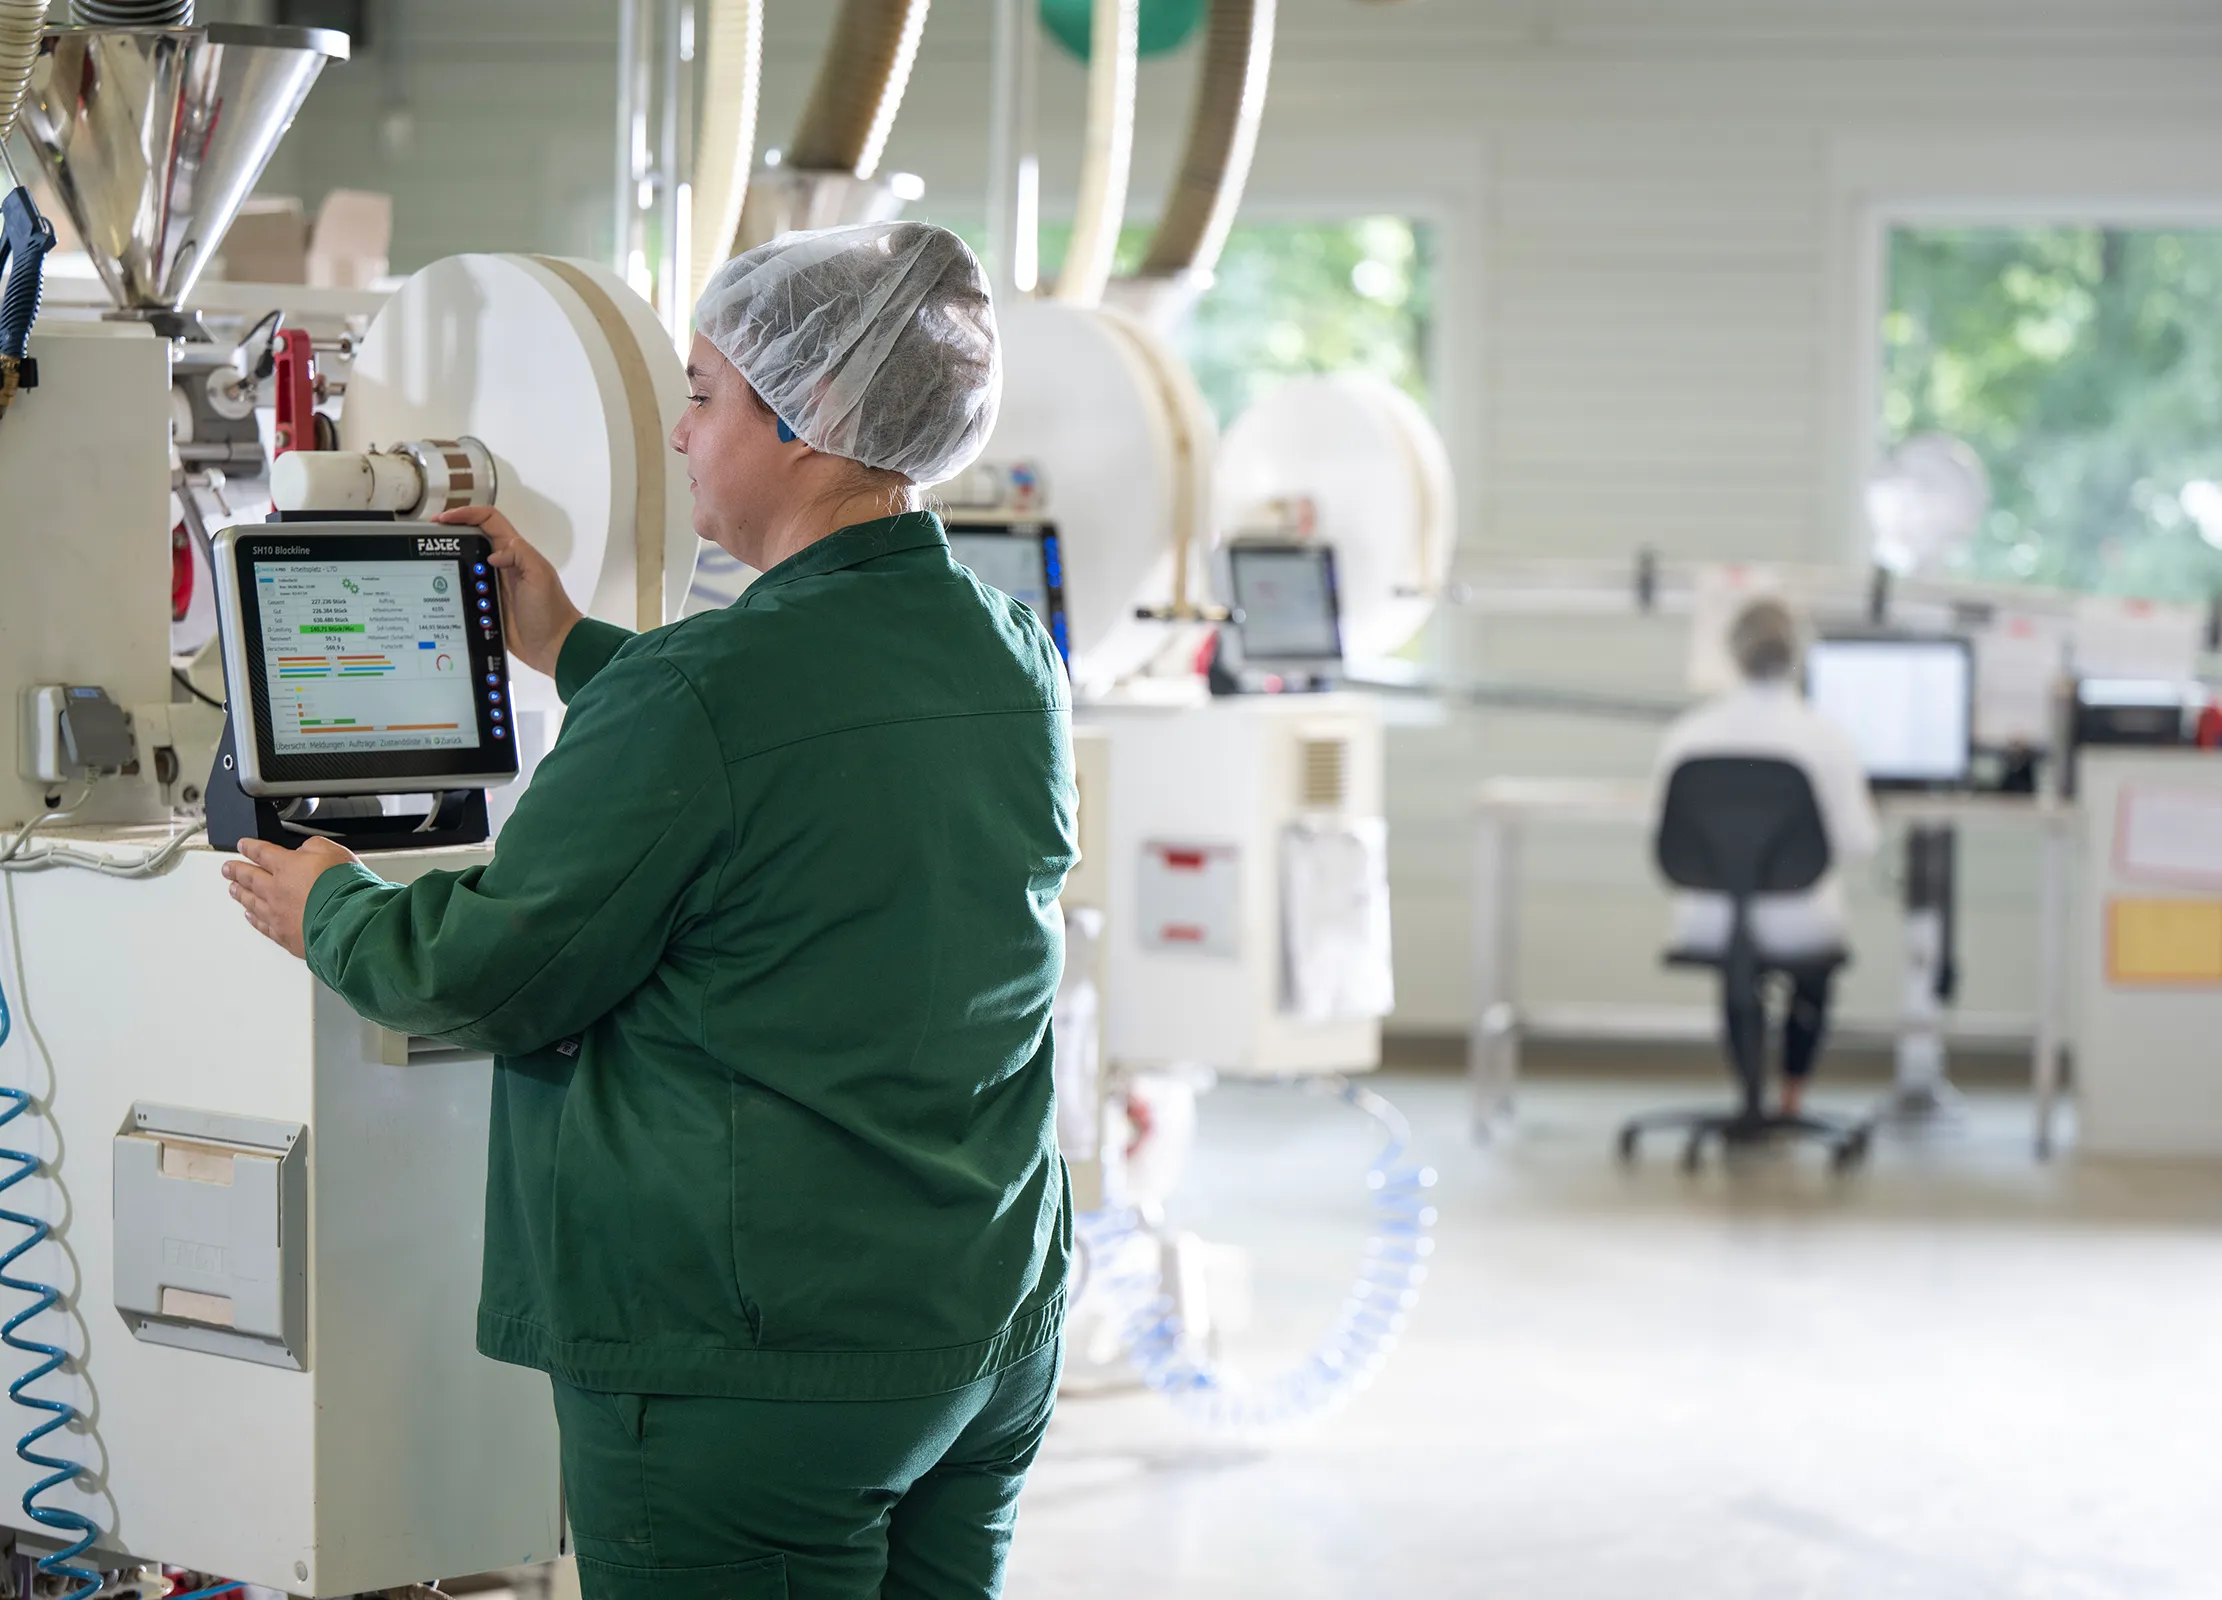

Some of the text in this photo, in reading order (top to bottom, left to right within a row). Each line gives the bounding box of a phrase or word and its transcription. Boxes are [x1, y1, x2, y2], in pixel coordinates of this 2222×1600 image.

[252, 545, 273, 555] SH10
[417, 538, 460, 551] FASTEC
[290, 565, 322, 573] Arbeitsplatz
[275, 740, 306, 751] Übersicht
[310, 740, 346, 749] Meldungen
[349, 739, 376, 749] Aufträge
[380, 738, 421, 747] Zustandsliste
[440, 737, 463, 746] Zurück
